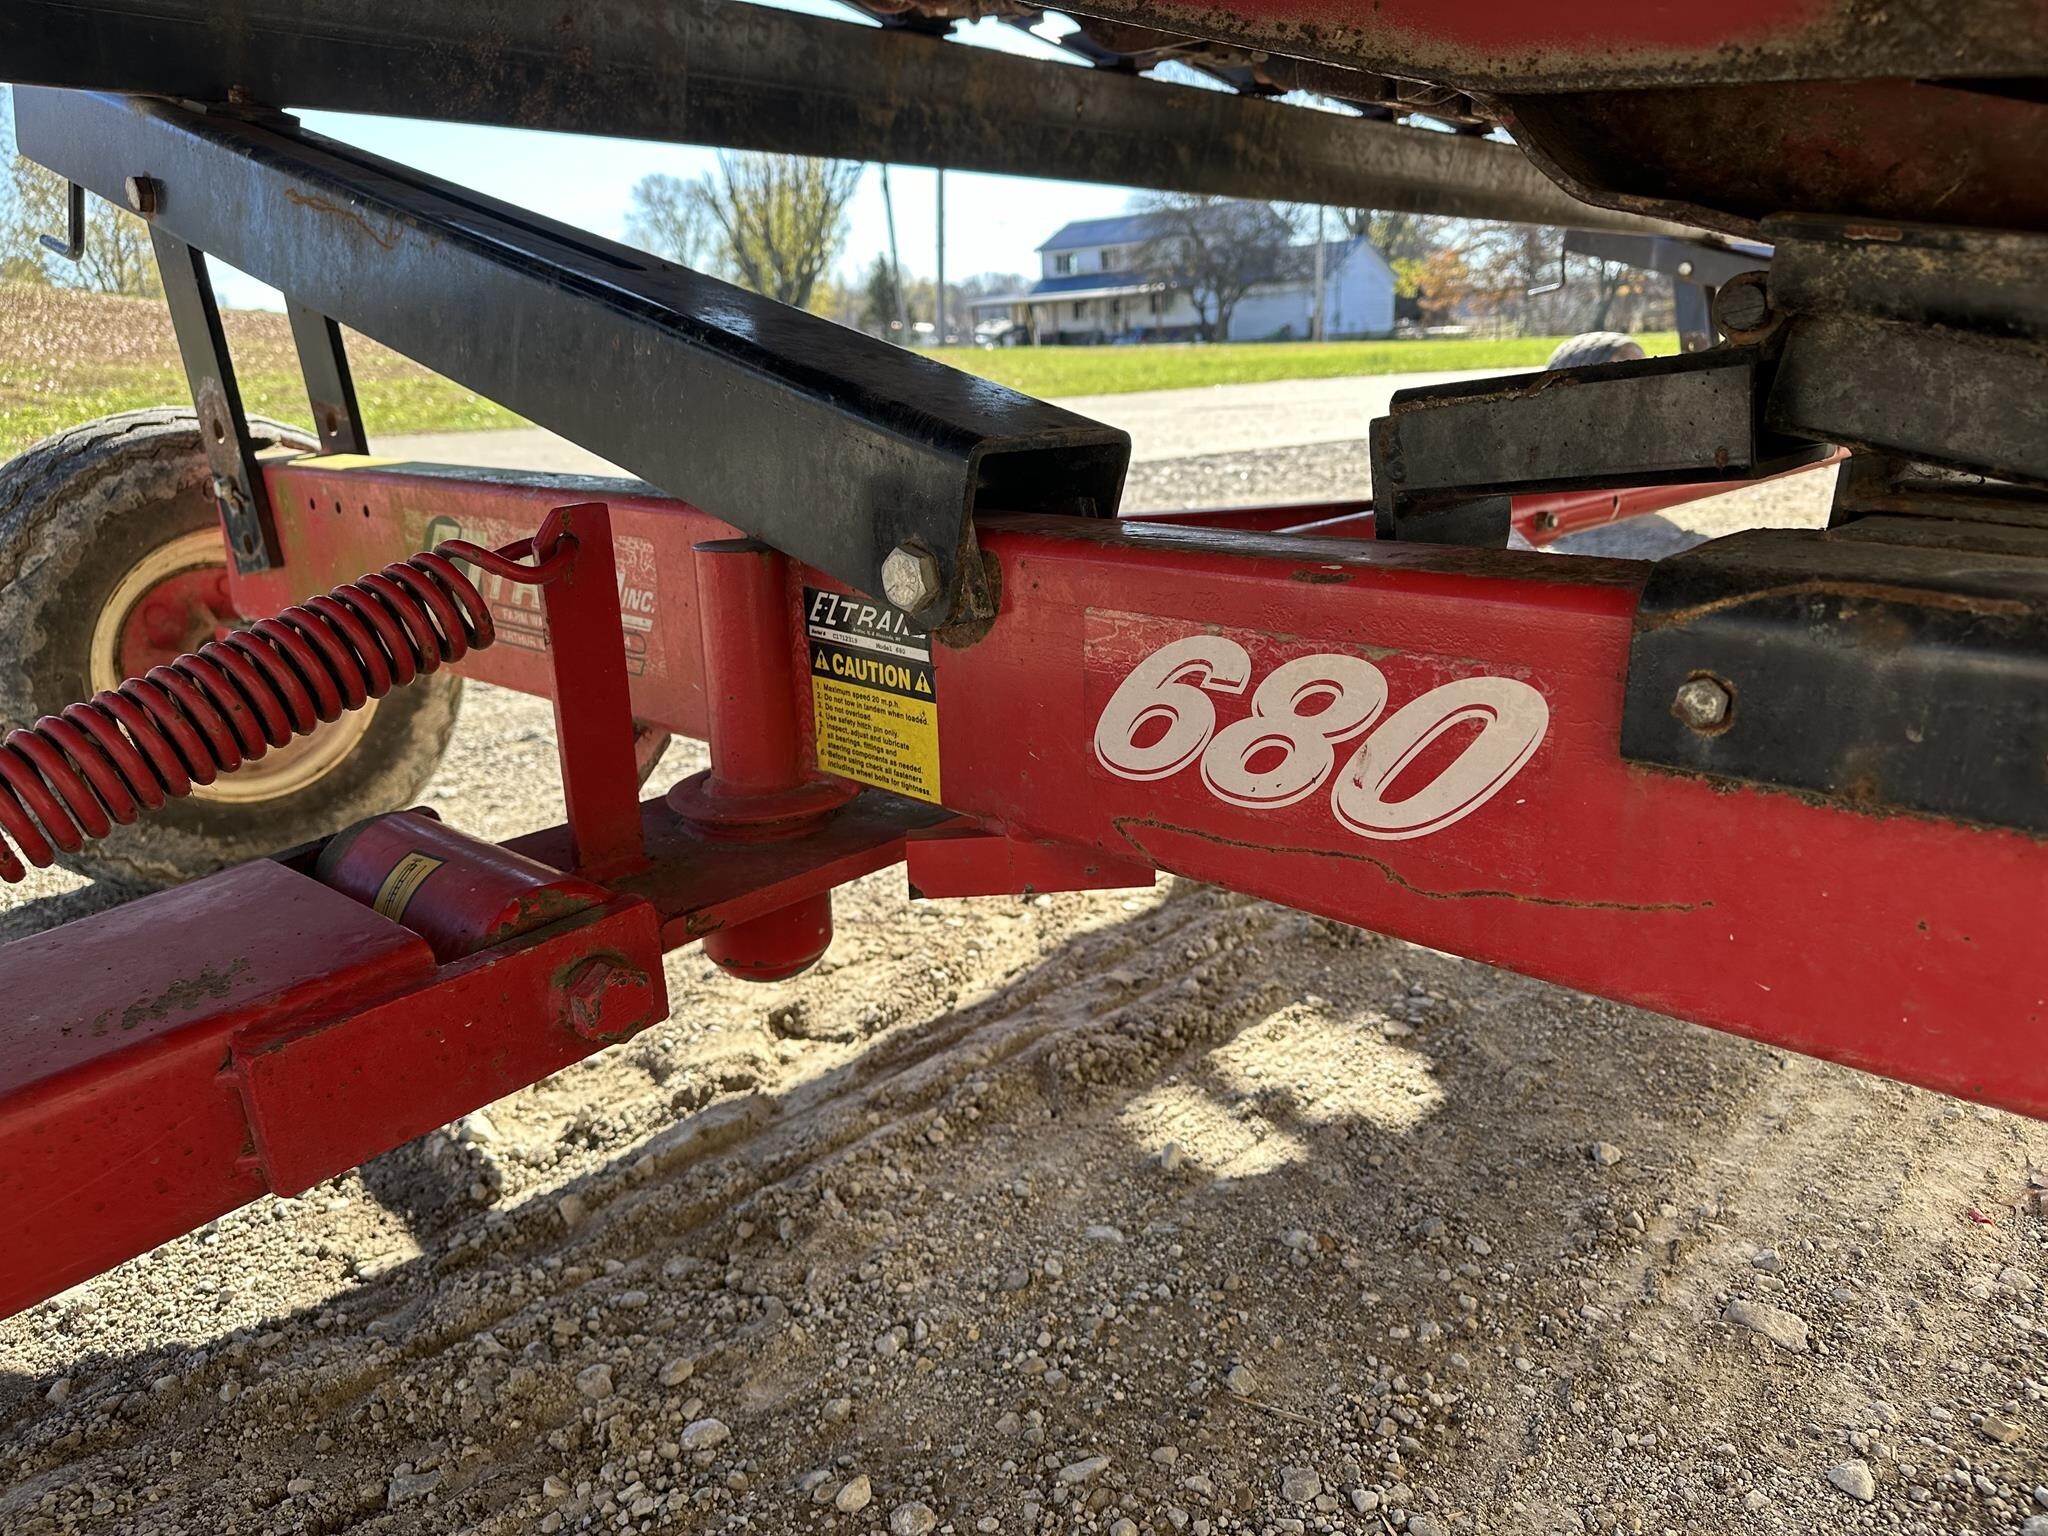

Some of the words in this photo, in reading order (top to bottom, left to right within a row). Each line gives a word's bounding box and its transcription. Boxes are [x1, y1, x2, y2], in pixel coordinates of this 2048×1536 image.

[622, 586, 656, 614] INC.
[832, 653, 911, 691] CAUTION
[823, 683, 851, 697] Maximum
[852, 691, 870, 702] speed
[871, 695, 880, 703] 20
[824, 693, 832, 701] Do
[833, 696, 843, 705] not
[856, 701, 862, 709] in
[863, 703, 886, 715] tandem
[887, 709, 904, 719] when
[825, 703, 833, 711] Do
[834, 705, 844, 714] not
[825, 712, 837, 721] Use
[838, 716, 856, 728] safety
[856, 721, 872, 730] hitch
[873, 726, 883, 734] pin
[850, 730, 869, 740] adjust
[882, 737, 910, 751] lubricate
[863, 742, 884, 754] fittings
[885, 749, 897, 757] and
[1094, 635, 1550, 841] 680
[827, 742, 851, 755] steering
[851, 749, 888, 764] components
[827, 760, 855, 775] including
[855, 770, 873, 778] wheel
[874, 773, 890, 784] bolts
[890, 777, 900, 786] for
[828, 750, 847, 761] Before
[848, 757, 865, 768] using
[865, 763, 883, 772] check
[893, 769, 922, 784] fasteners
